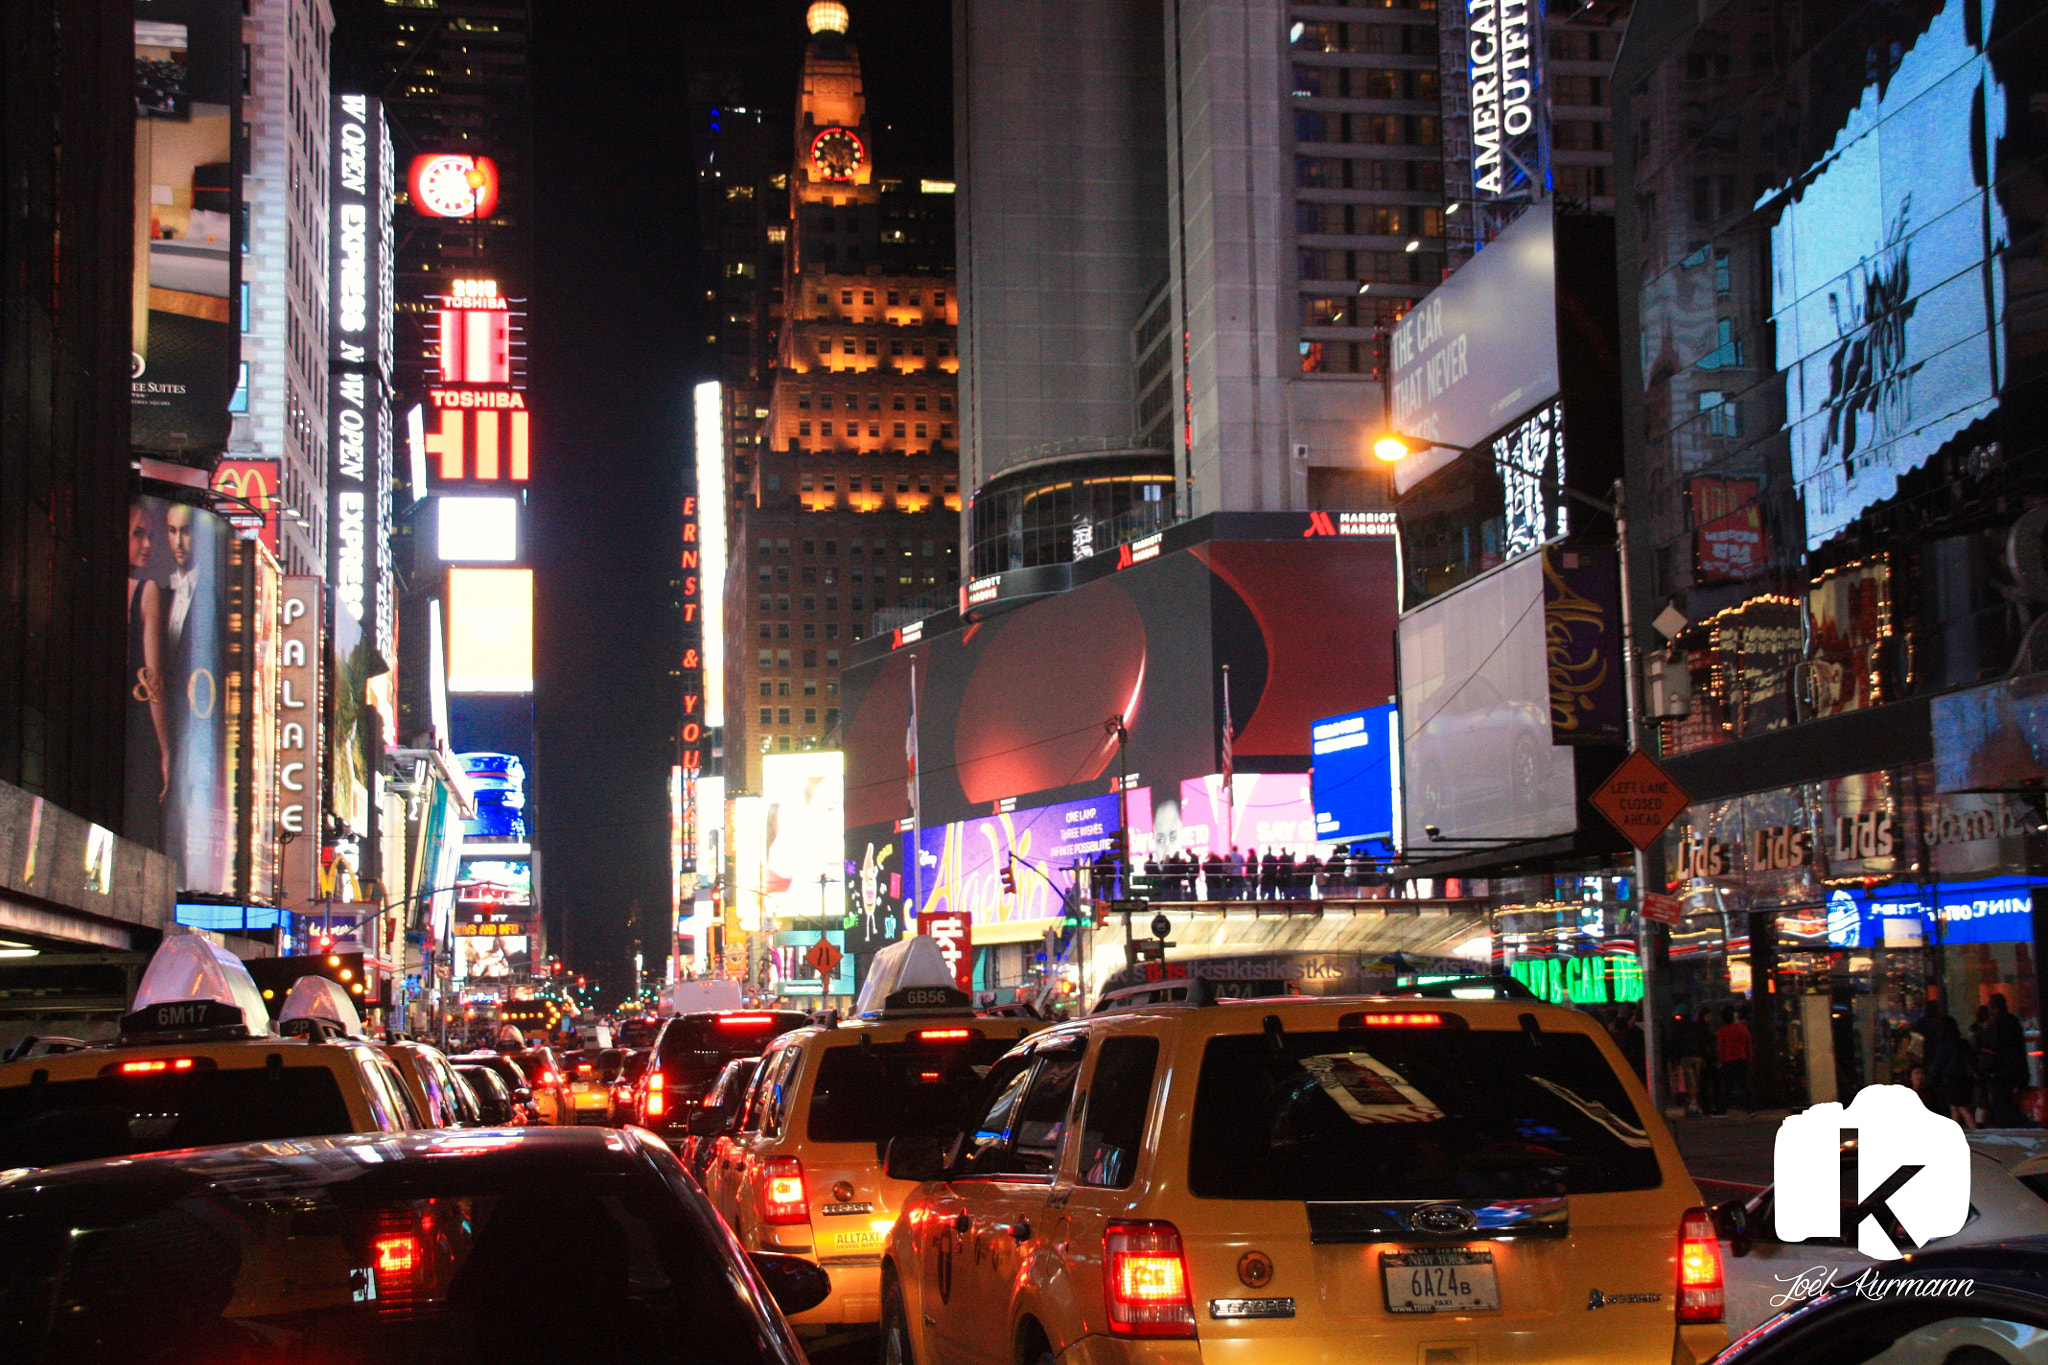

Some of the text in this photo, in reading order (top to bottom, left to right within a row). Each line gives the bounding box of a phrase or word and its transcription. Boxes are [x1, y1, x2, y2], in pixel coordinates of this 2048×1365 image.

[341, 124, 366, 195] OPEN
[340, 205, 366, 331] EXPRESS
[443, 297, 507, 309] TOSHIBA
[1392, 297, 1443, 372] THE CAR
[1394, 367, 1423, 420] THAT
[1427, 333, 1468, 402] NEVER
[431, 391, 525, 408] TOSHIBA
[339, 410, 364, 481] OPEN
[1340, 524, 1398, 534] MARQUIS
[681, 496, 698, 622] ERNST
[682, 649, 698, 668] &
[280, 598, 305, 832] PALACE
[1611, 782, 1670, 794] LEFT LANE
[1619, 798, 1663, 810] CLOSED
[1065, 810, 1080, 823] ONE
[1622, 813, 1661, 826] AHEAD
[1835, 811, 1894, 861] Lids
[1753, 824, 1804, 872] Lids
[1678, 836, 1724, 880] Lids
[474, 914, 508, 923] SNY
[479, 923, 497, 935] AND
[907, 991, 946, 1004] 6B56
[158, 1005, 207, 1026] 6M17
[837, 1232, 880, 1244] ALLTAXI
[1408, 1254, 1468, 1266] NEW YORK
